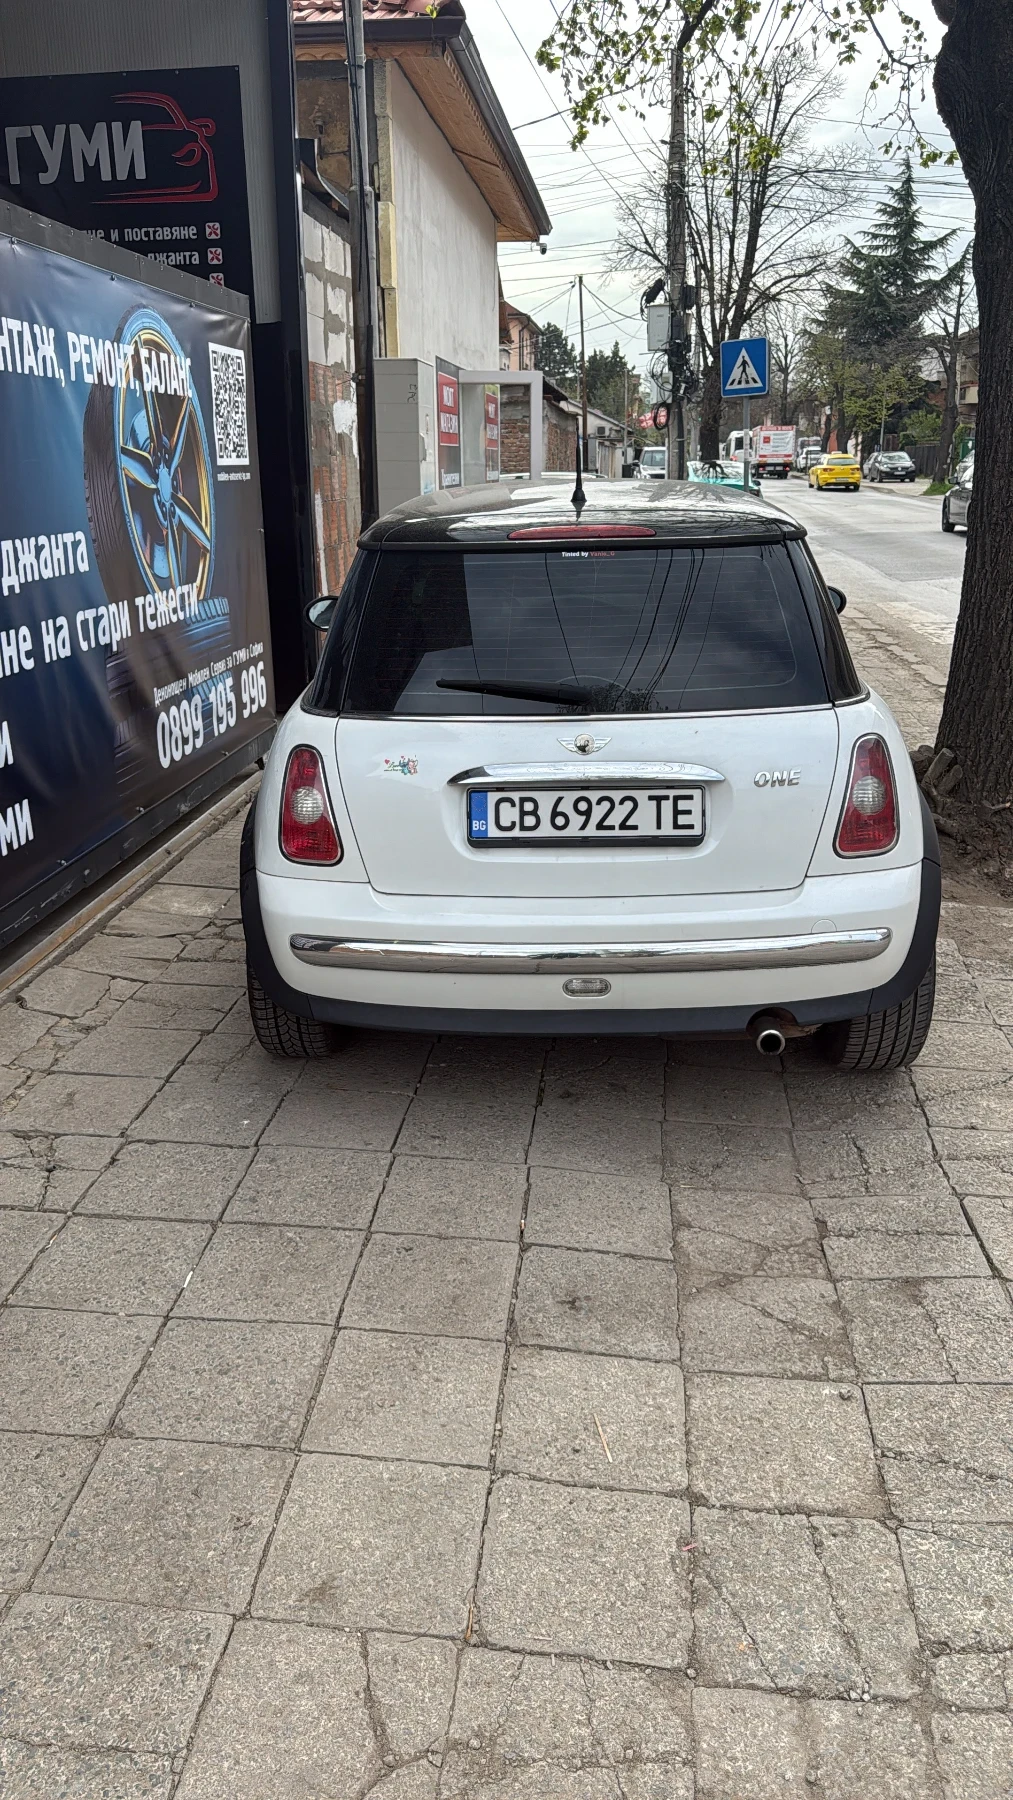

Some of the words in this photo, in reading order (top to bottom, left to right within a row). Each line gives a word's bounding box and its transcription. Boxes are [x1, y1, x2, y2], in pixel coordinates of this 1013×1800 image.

[4, 120, 147, 185] ГУМИ
[110, 228, 119, 242] и
[124, 225, 198, 242] поставяне
[140, 348, 193, 398] БАЛАНС
[1, 531, 90, 596] джанта
[41, 616, 72, 663] на
[76, 600, 132, 652] стари
[135, 582, 199, 633] тежести
[156, 694, 204, 769] 0899
[209, 677, 237, 737] 195
[241, 660, 268, 719] 996
[753, 769, 801, 788] ONE
[472, 820, 487, 831] BG
[494, 796, 541, 832] CB
[550, 795, 639, 831] 6922
[648, 794, 695, 830] TE
